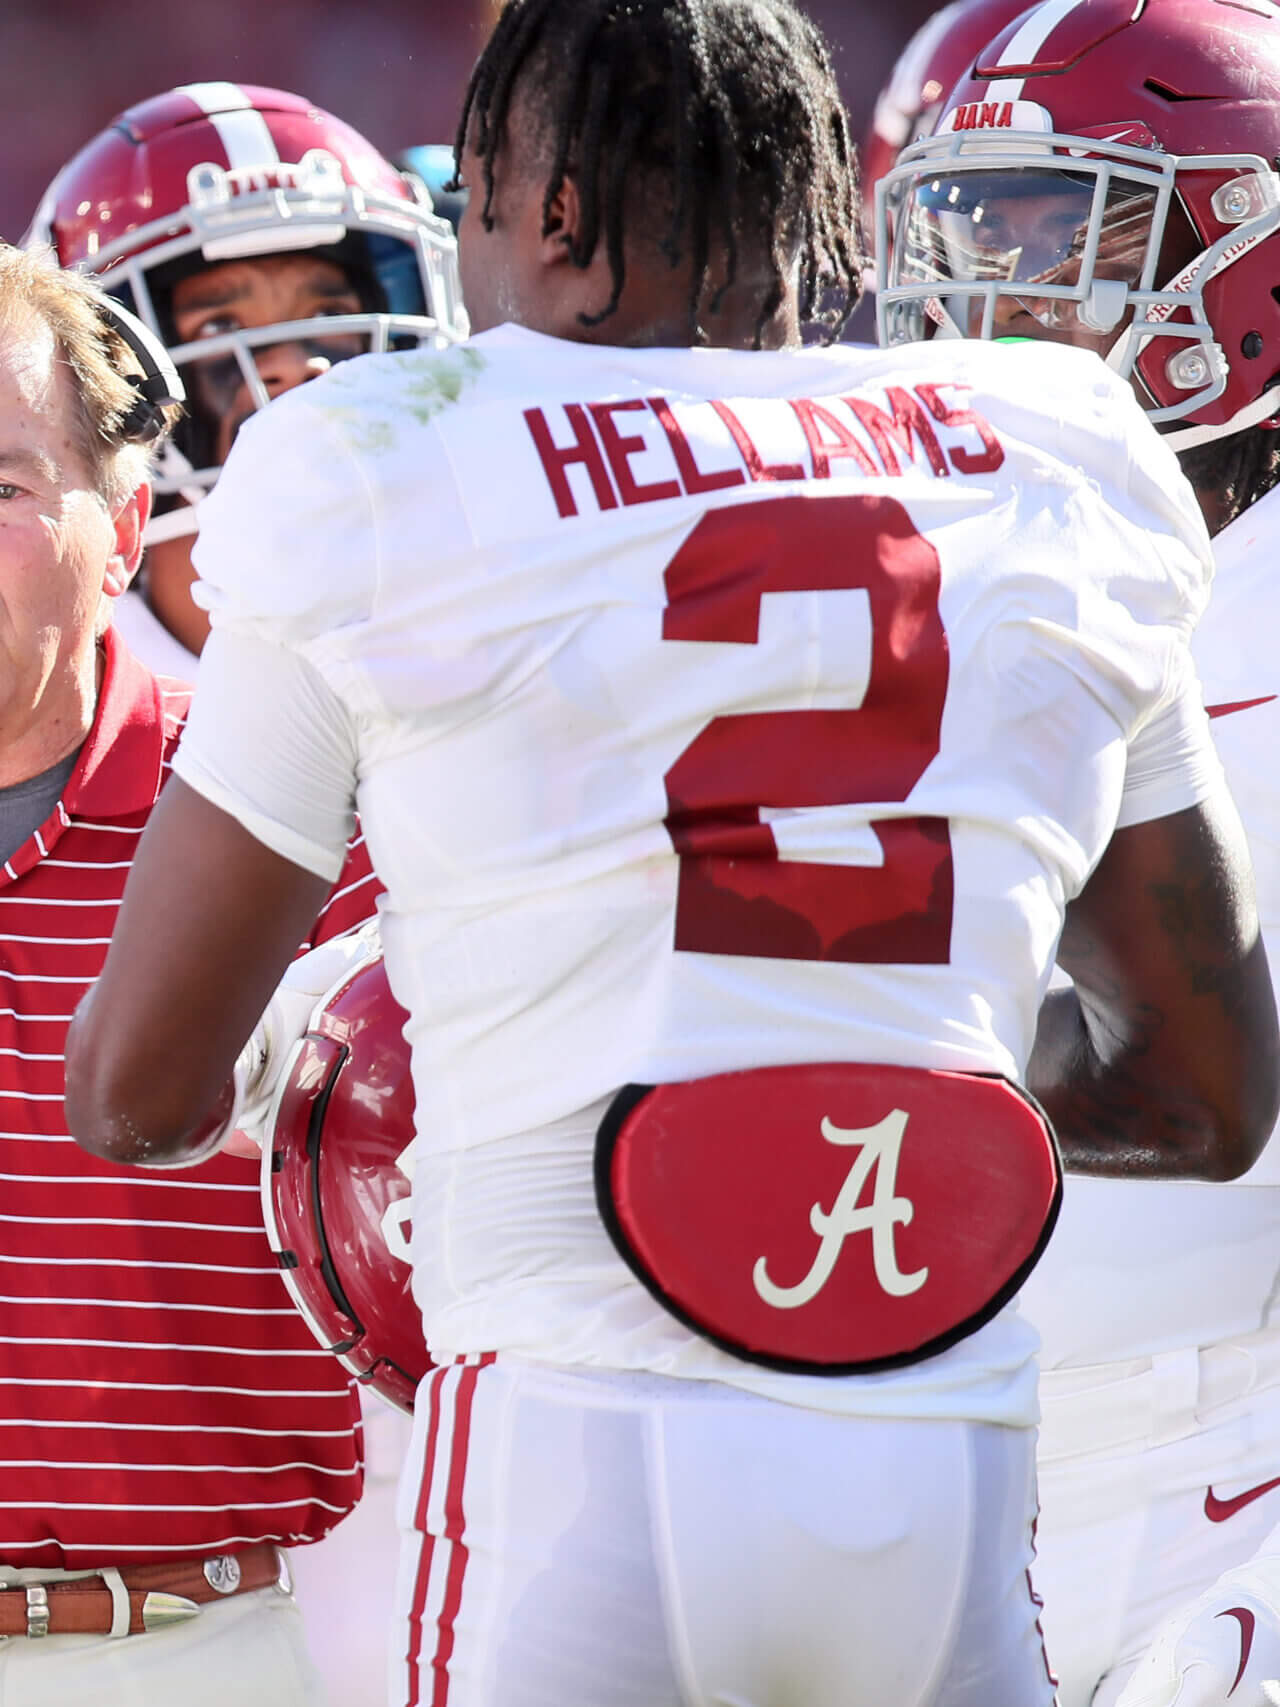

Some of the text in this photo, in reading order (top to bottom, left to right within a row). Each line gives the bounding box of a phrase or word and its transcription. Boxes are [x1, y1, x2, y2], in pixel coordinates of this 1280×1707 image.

[523, 383, 1005, 519] HELLAMS
[662, 494, 954, 964] 2
[753, 1108, 928, 1309] A
